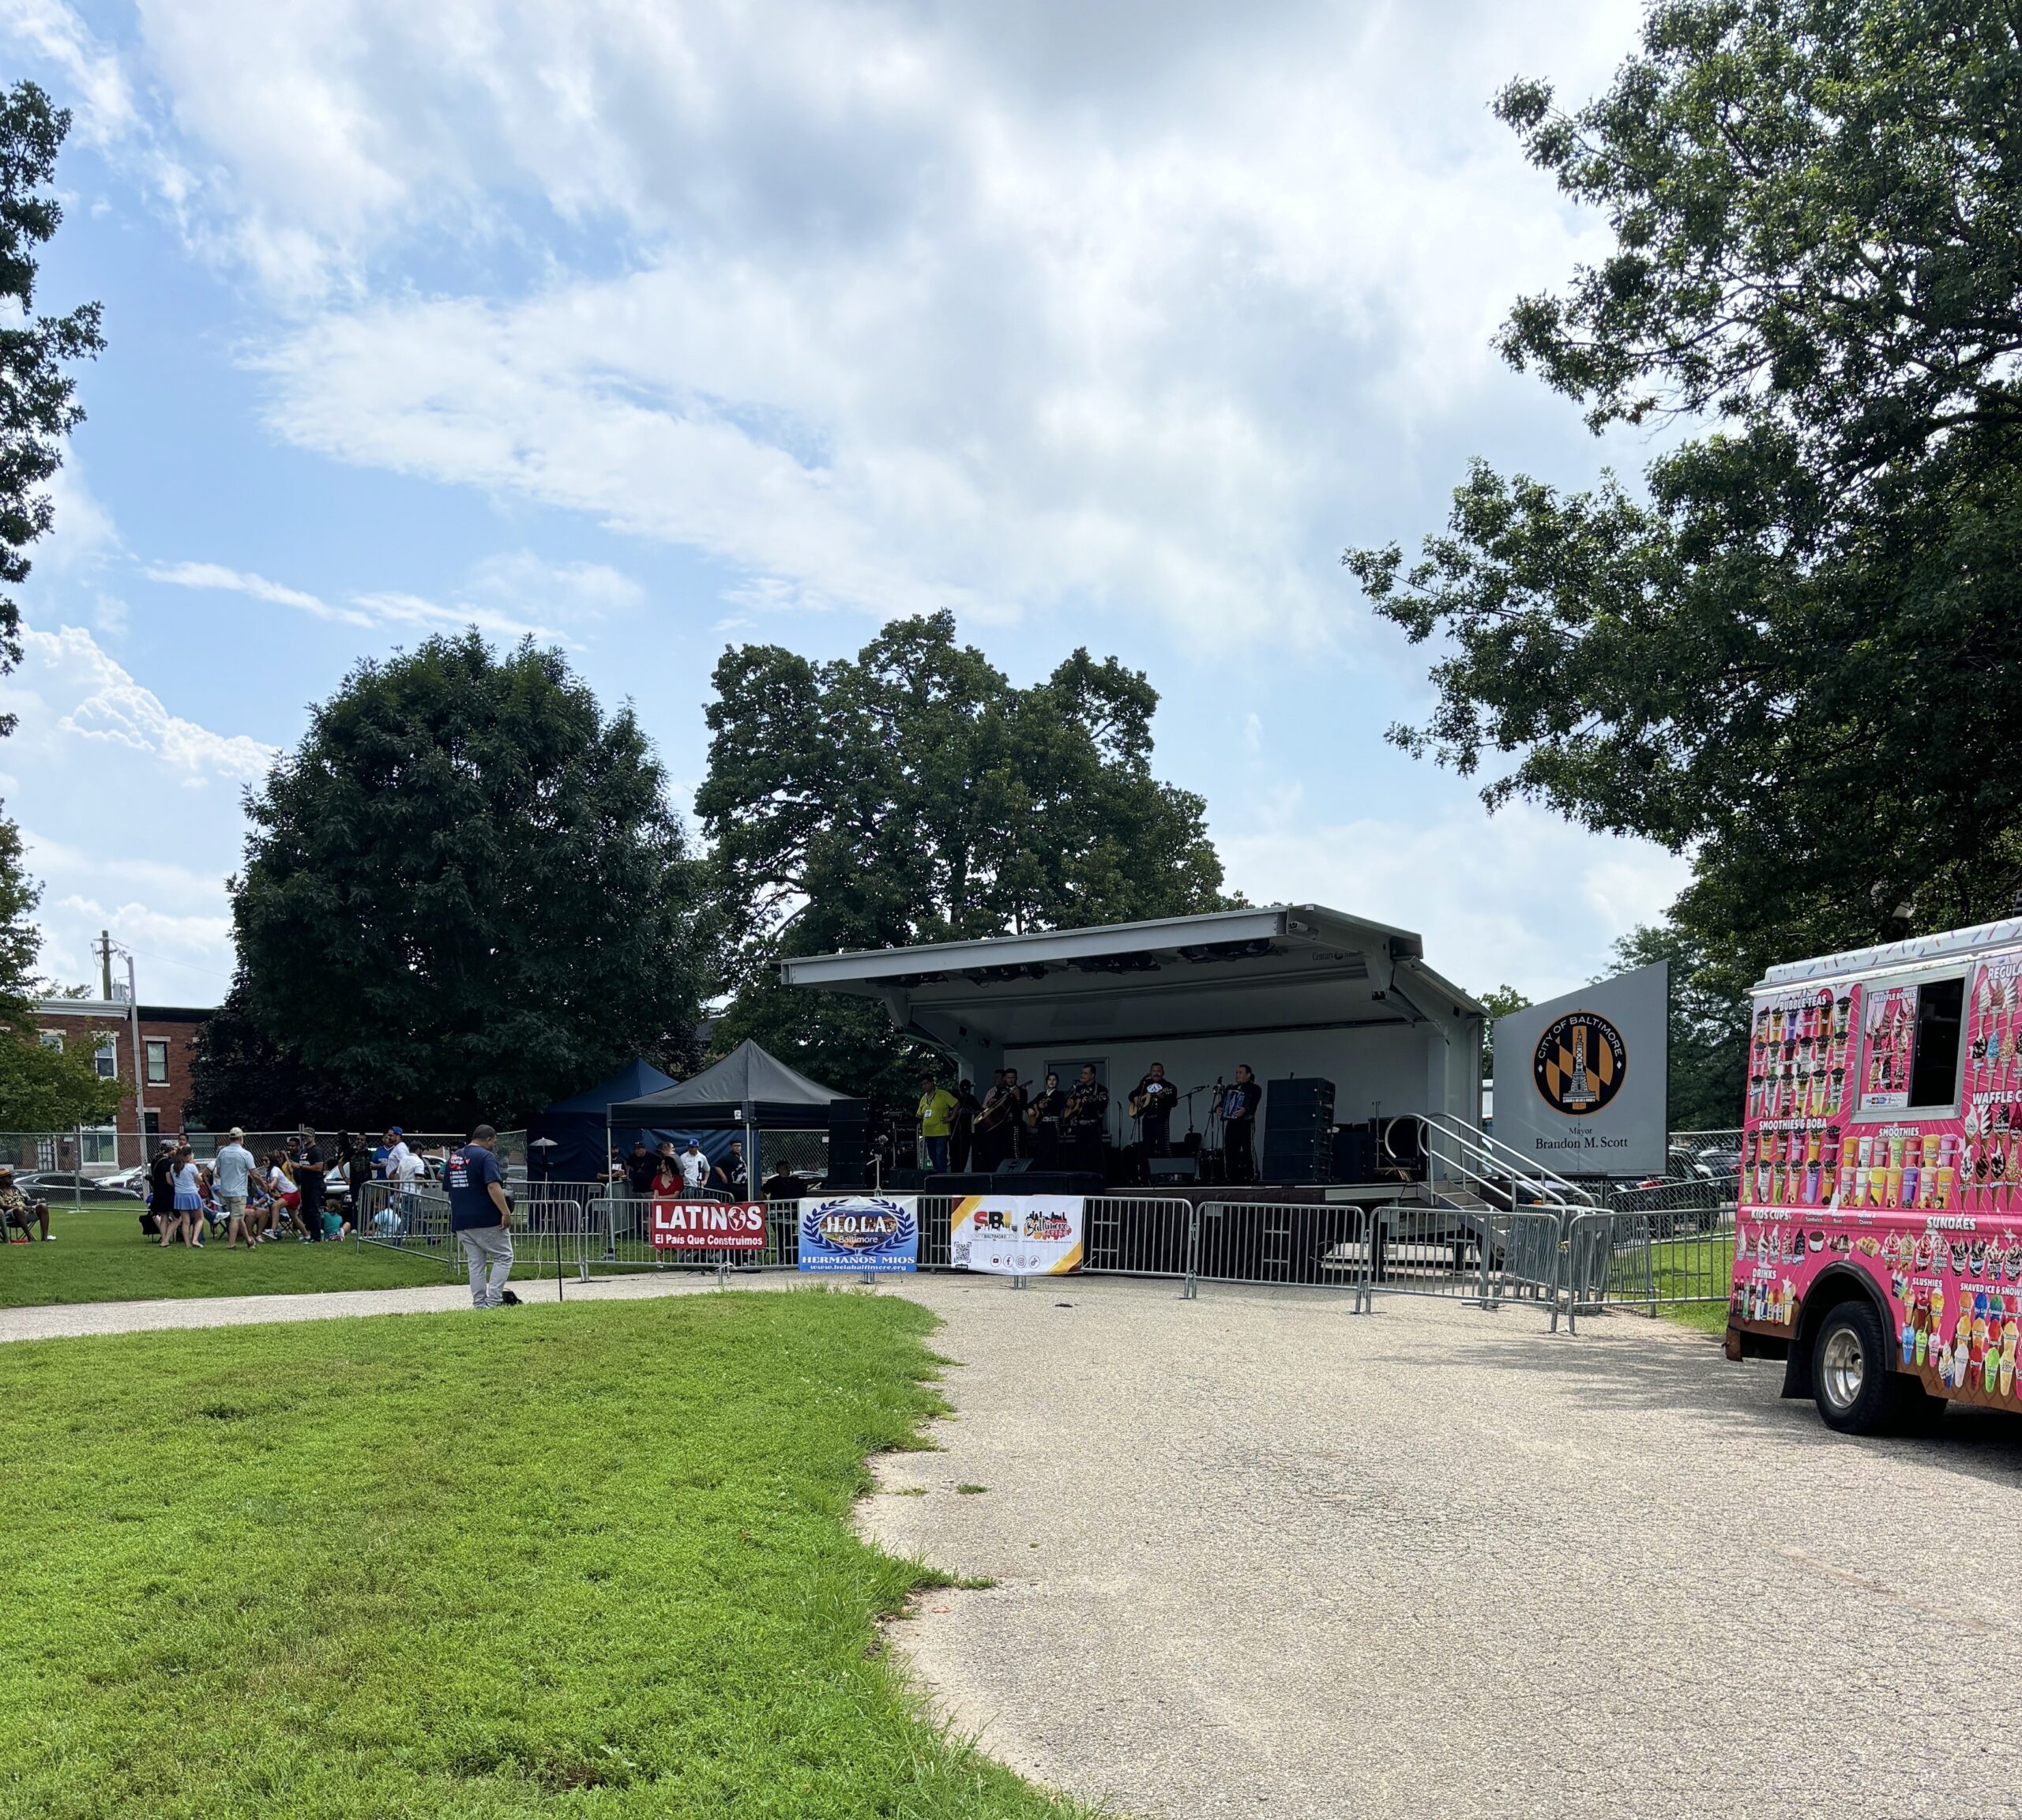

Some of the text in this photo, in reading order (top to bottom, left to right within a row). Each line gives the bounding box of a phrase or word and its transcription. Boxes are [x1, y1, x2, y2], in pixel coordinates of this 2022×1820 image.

[1988, 964, 2022, 980] REGULA
[1779, 995, 1827, 1011] BUBBLE TEAS
[1874, 991, 1916, 1003] WAFFLE BOWLS
[1538, 1016, 1622, 1059] CITY OF BALTIMORE
[1972, 1090, 2014, 1105] WAFFLE
[1759, 1118, 1827, 1130] SMOOTHIES & BOBA
[1569, 1127, 1592, 1137] Mayor
[1878, 1126, 1919, 1138] SMOOTHIES
[1535, 1137, 1628, 1149] Brandon M. Scott
[656, 1205, 762, 1231] LATINOS
[1751, 1209, 1790, 1221] KIDS CUPS
[1025, 1216, 1069, 1236] Baltimore
[1926, 1216, 1976, 1231] SUNDAES
[655, 1234, 763, 1246] El País Que Construimos
[1752, 1268, 1776, 1280] DRINKS
[1911, 1277, 1943, 1288] SLUSHIES
[1960, 1282, 1984, 1293] SHAVED
[1985, 1285, 1995, 1294] ICE
[2001, 1287, 2022, 1297] SNOW
